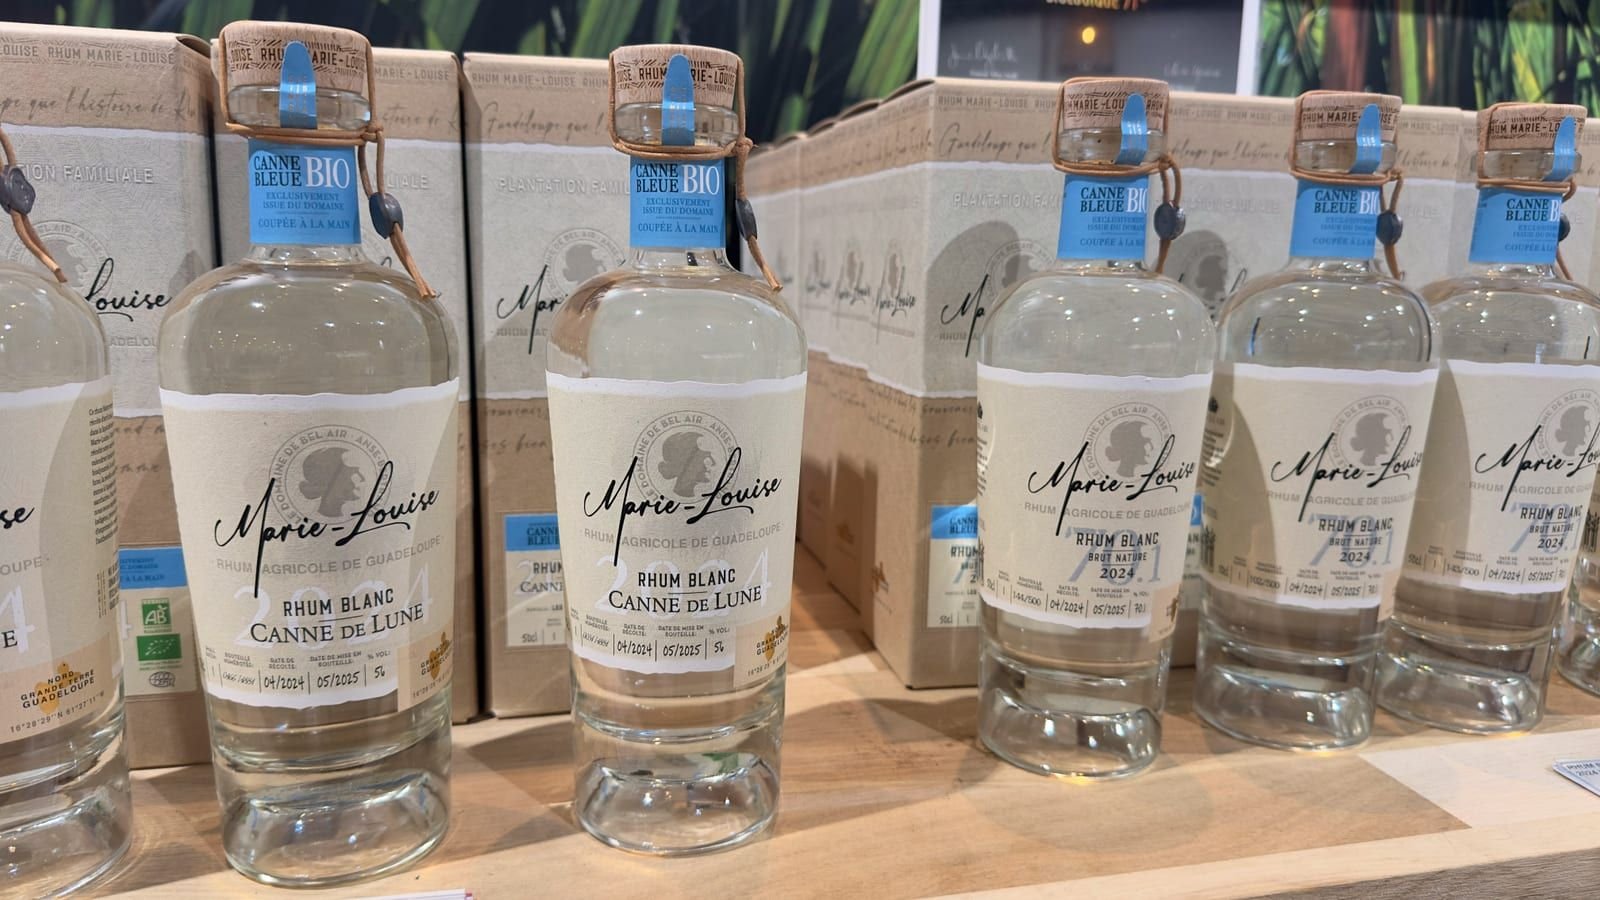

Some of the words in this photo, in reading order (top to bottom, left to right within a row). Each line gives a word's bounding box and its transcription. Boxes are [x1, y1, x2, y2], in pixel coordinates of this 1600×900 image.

[48, 47, 81, 59] RHUM
[63, 163, 154, 184] FAMILIALE
[254, 155, 301, 172] CANNE
[304, 156, 350, 189] BIO
[254, 171, 302, 187] BLEUE
[635, 163, 679, 178] CANNE
[682, 164, 720, 195] BIO
[499, 176, 586, 194] PLANTATION
[636, 178, 679, 193] BLEUE
[1080, 186, 1125, 200] CANNE
[266, 191, 340, 201] EXCLUSIVEMENT
[646, 198, 711, 207] EXCLUSIVEMENT
[1315, 190, 1358, 202] CANNE
[1506, 198, 1549, 210] CANNE
[263, 200, 287, 210] ISSUE
[288, 201, 300, 211] DU
[303, 201, 344, 211] DOMAINE
[642, 206, 663, 215] ISSUE
[665, 206, 678, 215] DU
[680, 206, 715, 216] DOMAINE
[1080, 200, 1125, 213] BLEUE
[1313, 202, 1358, 214] BLEUE
[258, 215, 297, 229] COUPÉE
[300, 215, 309, 229] À
[311, 218, 325, 229] LA
[328, 219, 351, 230] MAIN
[1505, 210, 1548, 222] BLEUE
[638, 221, 673, 233] COUPÉE
[675, 221, 685, 233] À
[686, 223, 697, 233] LA
[699, 224, 719, 234] MAIN
[646, 424, 661, 438] DE
[661, 415, 681, 428] BEL
[684, 414, 703, 424] AIR
[283, 441, 300, 457] DE
[299, 430, 323, 446] BEL
[327, 428, 348, 439] AIR
[1474, 421, 1600, 512] Marie-Lou
[1468, 481, 1503, 493] RHUM
[1511, 484, 1562, 496] AGRICOLE
[583, 446, 782, 568] Marie-Louise
[1307, 494, 1365, 506] AGRICOLE
[1024, 501, 1057, 515] RHUM
[1063, 507, 1123, 520] AGRICOLE
[1125, 509, 1141, 520] DE
[1520, 507, 1554, 521] RHUM
[1557, 504, 1583, 519] BLANC
[214, 460, 440, 599] Marie-Louise
[1318, 517, 1355, 533] RHUM
[1359, 517, 1394, 531] BLANC
[1529, 525, 1550, 534] BRUT
[1551, 523, 1574, 534] NATURE
[584, 527, 614, 544] RHUM
[621, 534, 688, 549] AGRICOLE
[691, 536, 709, 549] DE
[712, 522, 782, 547] GUADELOUPE
[1076, 532, 1115, 548] RHUM
[1120, 531, 1159, 547] BLANC
[1329, 537, 1351, 546] BRUT
[1354, 536, 1383, 546] NATURE
[1537, 538, 1564, 549] 2024
[216, 557, 253, 574] RHUM
[262, 560, 338, 576] AGRICOLE
[342, 558, 362, 571] DE
[366, 535, 441, 568] GUADELOUPE
[1088, 552, 1112, 563] BRUT
[1115, 552, 1148, 563] NATURE
[1339, 551, 1371, 563] 2024
[637, 571, 681, 588] RHUM
[688, 568, 737, 588] BLANC
[1099, 566, 1135, 580] 2024
[1488, 567, 1520, 582] 04/2024
[1288, 581, 1323, 596] 04/2024
[283, 599, 333, 617] RHUM
[341, 588, 395, 614] BLANC
[608, 589, 681, 613] CANNE
[687, 599, 709, 613] DE
[714, 586, 763, 611] LUNE
[1050, 599, 1084, 614] 04/2024
[1092, 603, 1127, 615] 05/2025
[145, 609, 168, 626] AB
[250, 622, 335, 644] CANNE
[341, 624, 367, 640] DE
[370, 603, 425, 634] LUNE
[617, 640, 653, 657] 04/2024
[662, 643, 702, 657] 05/2025
[714, 640, 725, 653] 56
[20, 682, 65, 702] GRANDE
[68, 668, 95, 686] TERRE
[47, 670, 75, 685] NORD
[264, 674, 305, 691] 04/2024
[317, 670, 361, 689] 05/2025
[374, 664, 386, 680] 56
[22, 676, 95, 709] GUADELOUPE
